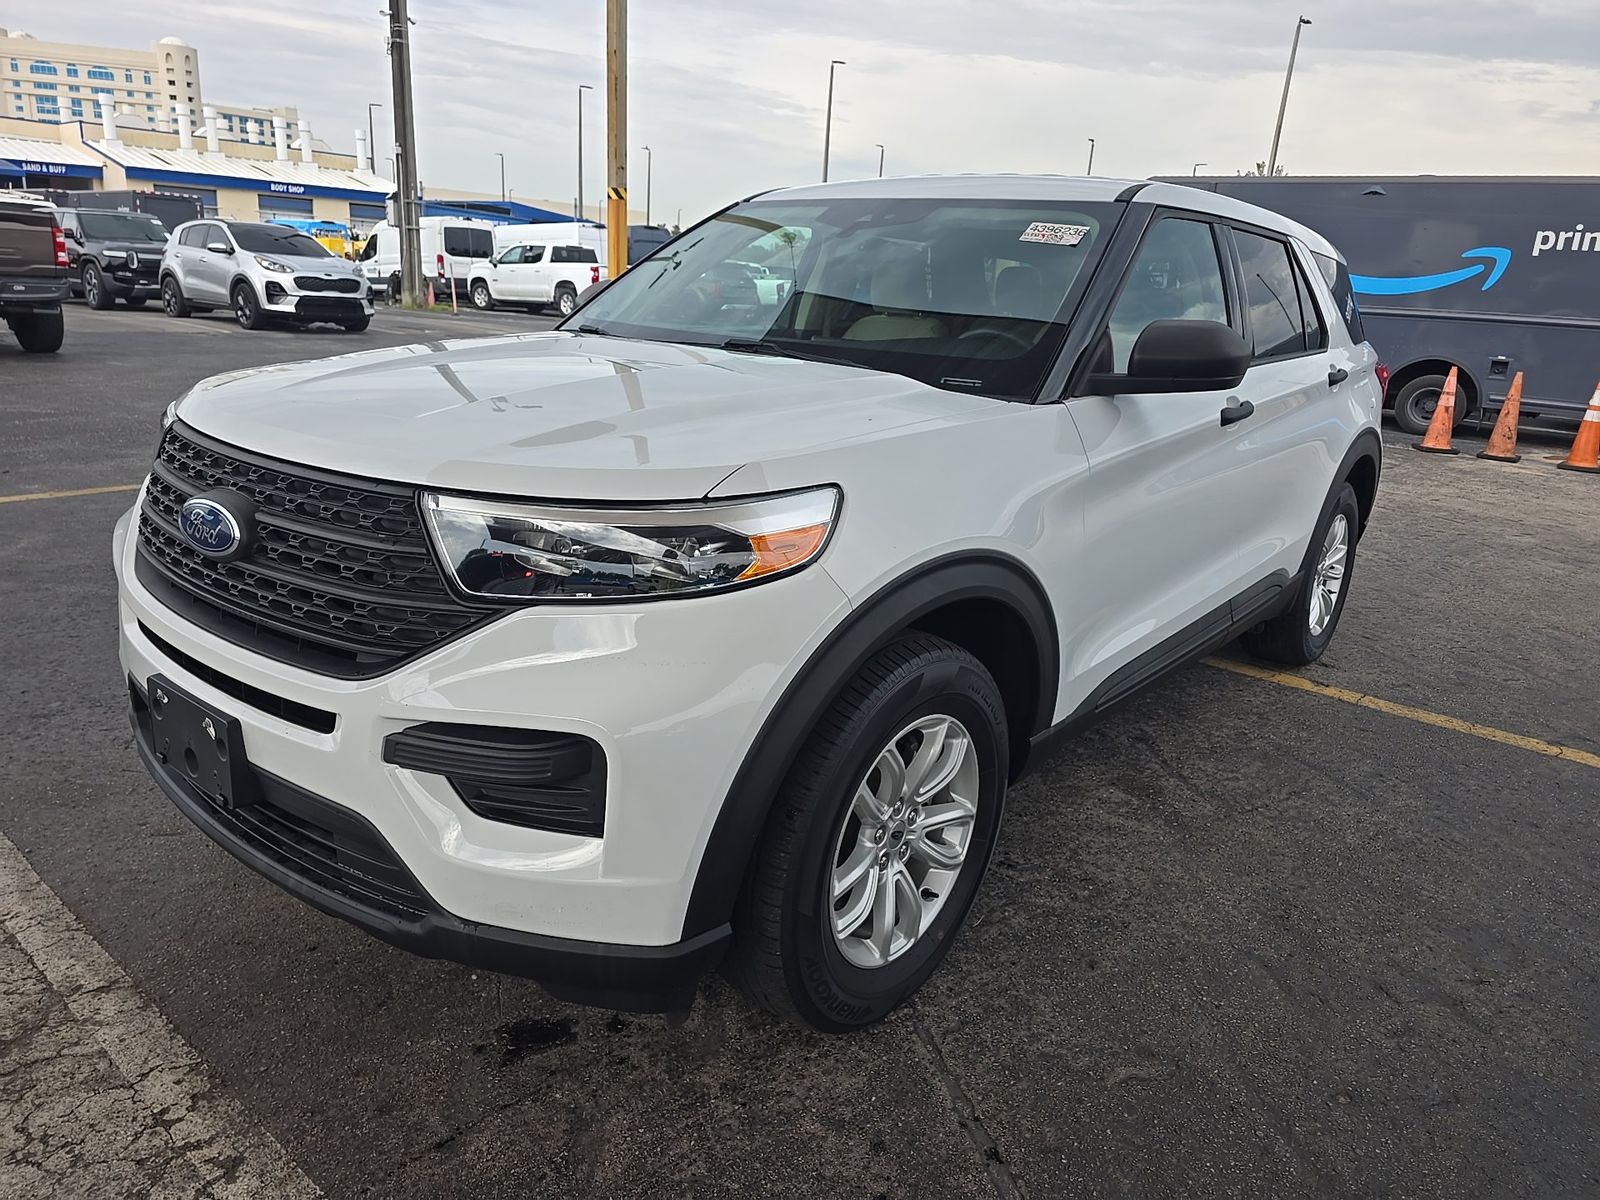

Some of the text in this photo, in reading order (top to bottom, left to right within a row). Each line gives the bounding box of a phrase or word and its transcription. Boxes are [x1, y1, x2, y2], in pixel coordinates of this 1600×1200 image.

[22, 162, 66, 174] SAND & BUFF
[271, 183, 304, 195] BODY SHOP
[1029, 223, 1088, 237] 4396236
[186, 508, 222, 545] Ford
